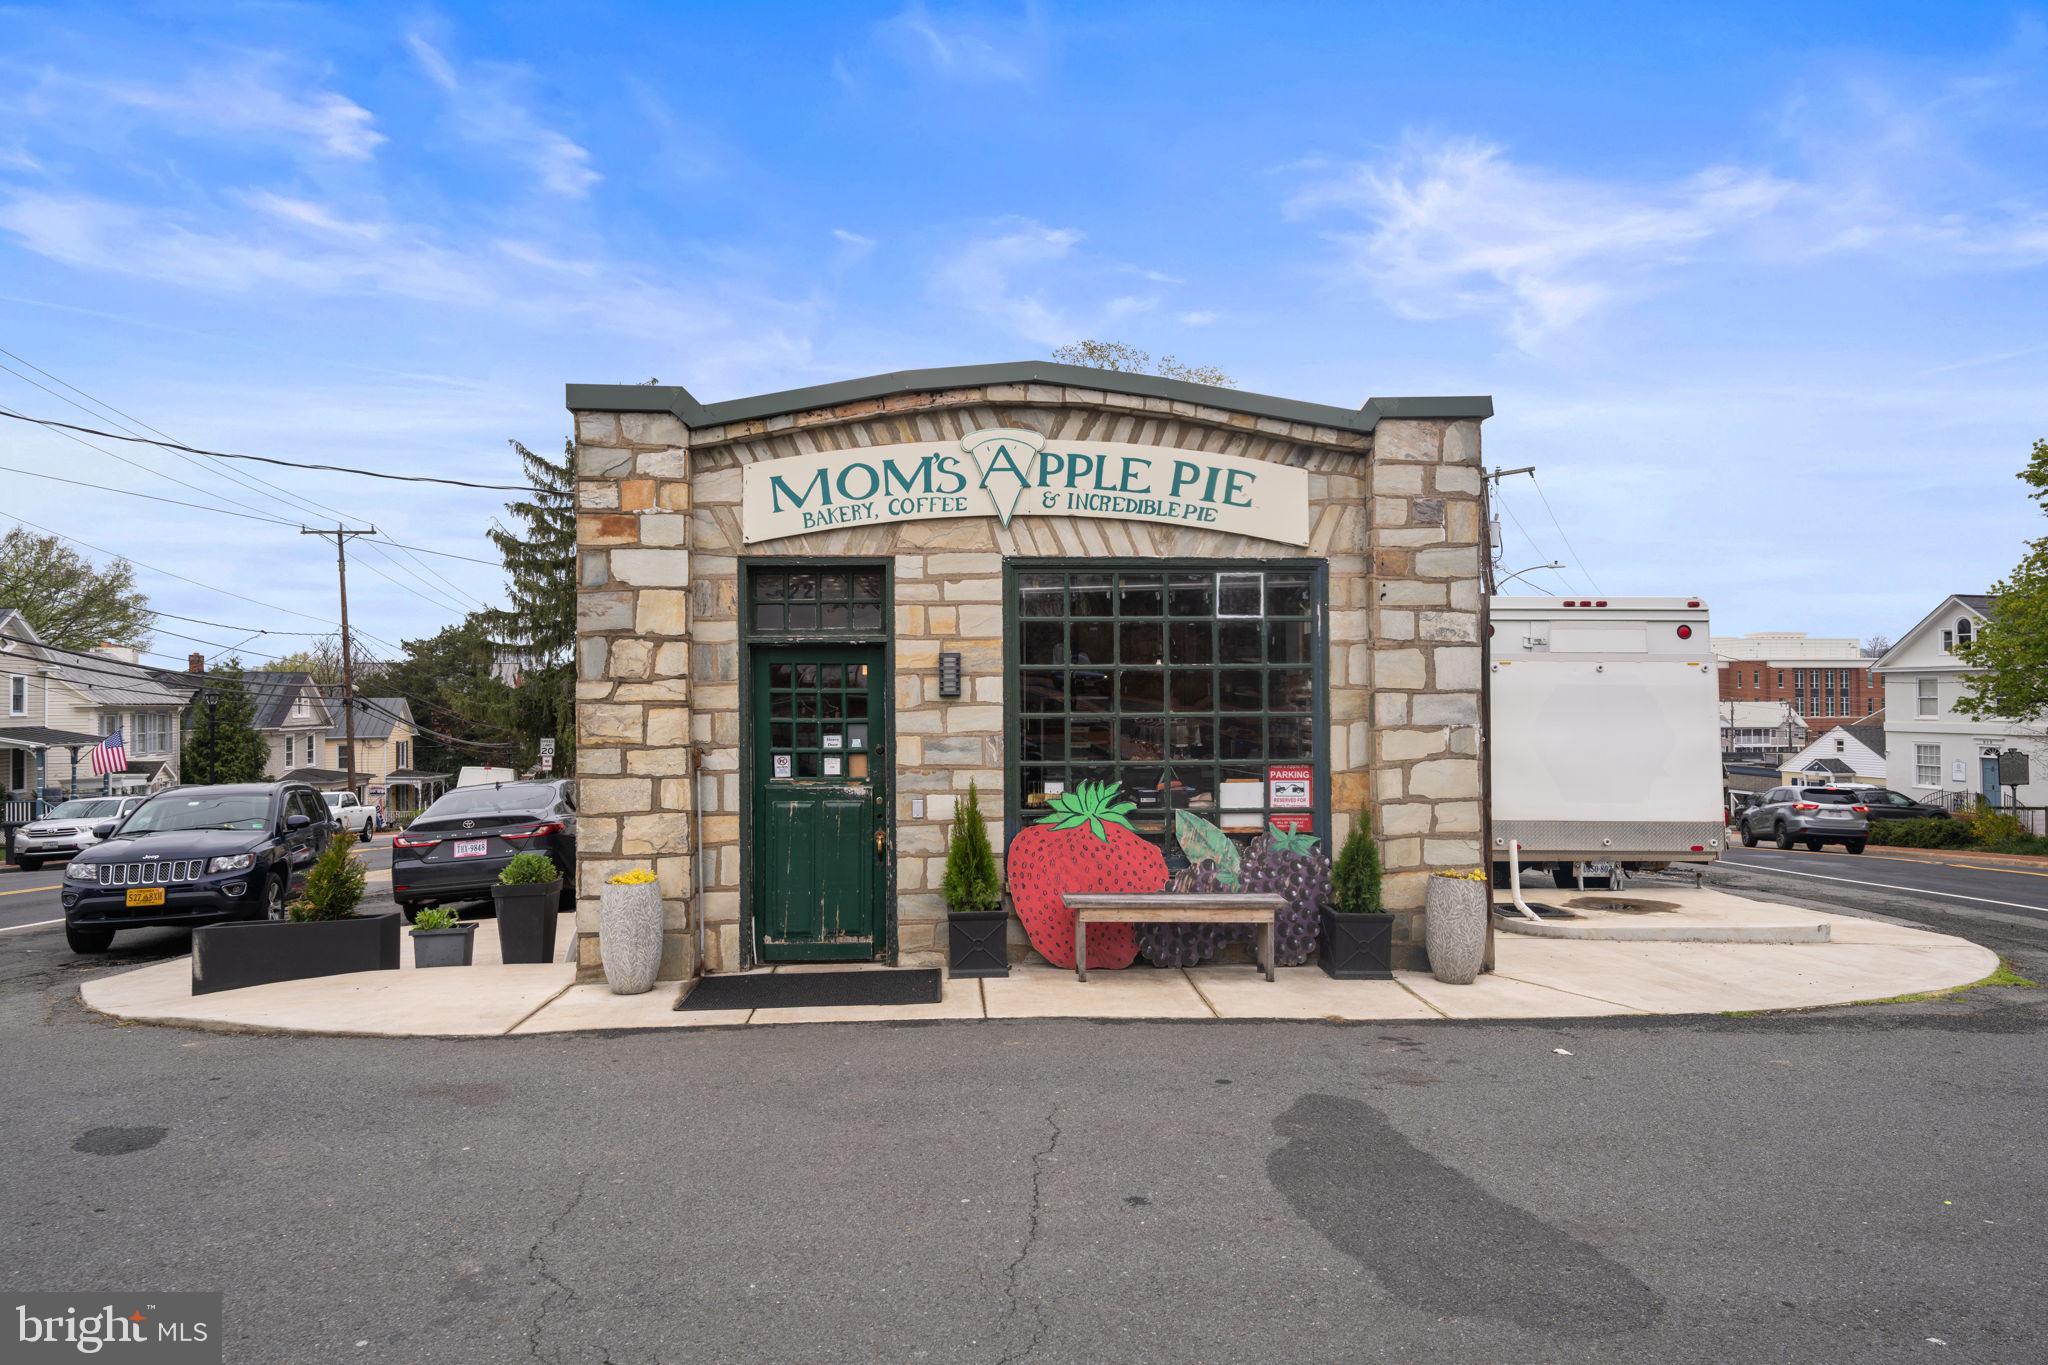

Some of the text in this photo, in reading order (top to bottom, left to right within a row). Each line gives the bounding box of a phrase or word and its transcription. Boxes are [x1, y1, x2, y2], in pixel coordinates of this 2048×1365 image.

[769, 452, 967, 513] MOM'S
[1169, 459, 1257, 508] PIE
[802, 497, 967, 529] BAKERY, COFFEE
[1042, 491, 1218, 522] & INCREDIBLE PIE
[541, 747, 553, 755] 20
[1270, 770, 1310, 779] PARKING
